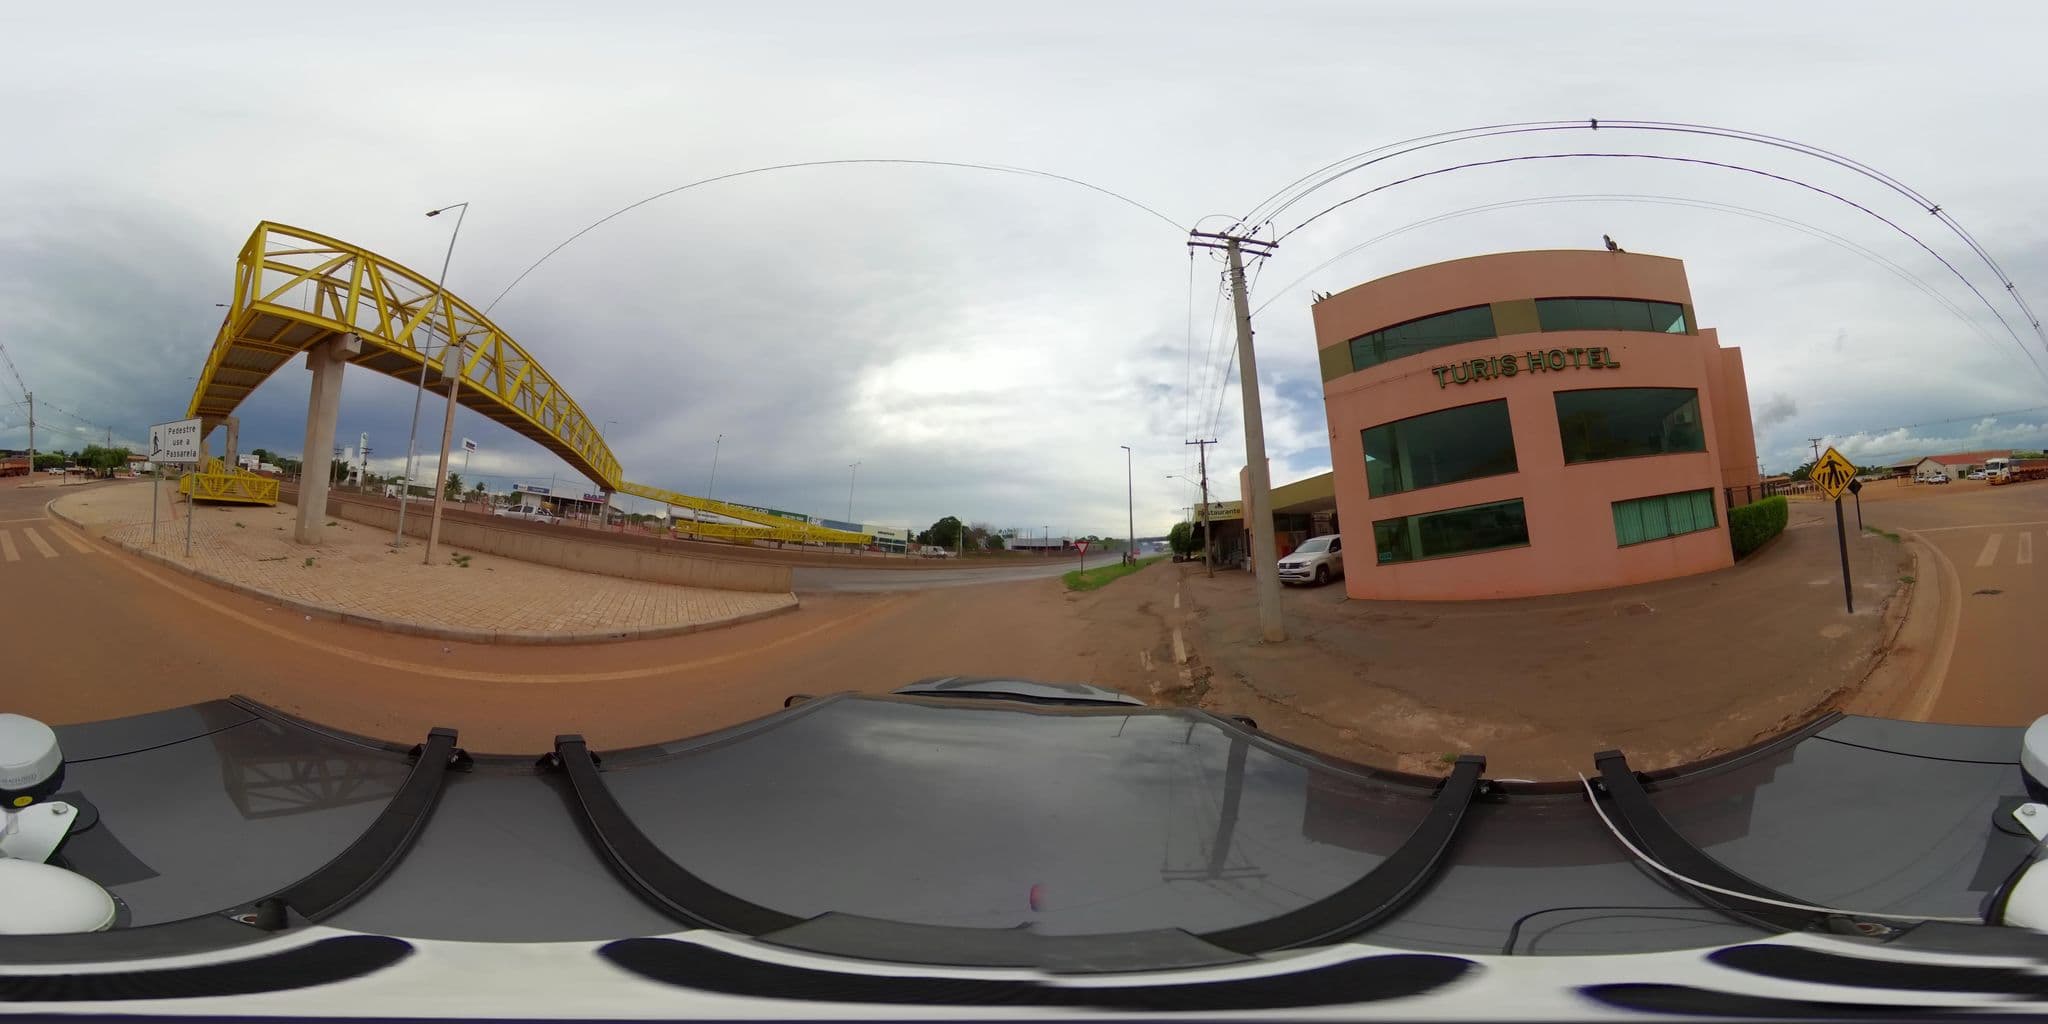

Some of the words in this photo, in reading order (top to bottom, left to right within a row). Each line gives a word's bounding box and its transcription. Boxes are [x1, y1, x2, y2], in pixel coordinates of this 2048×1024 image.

[1432, 354, 1519, 389] TURIS
[1526, 346, 1621, 374] HOTEL
[168, 425, 196, 435] Pedestre
[166, 449, 197, 458] Passarela
[1198, 508, 1241, 517] Rstaurante
